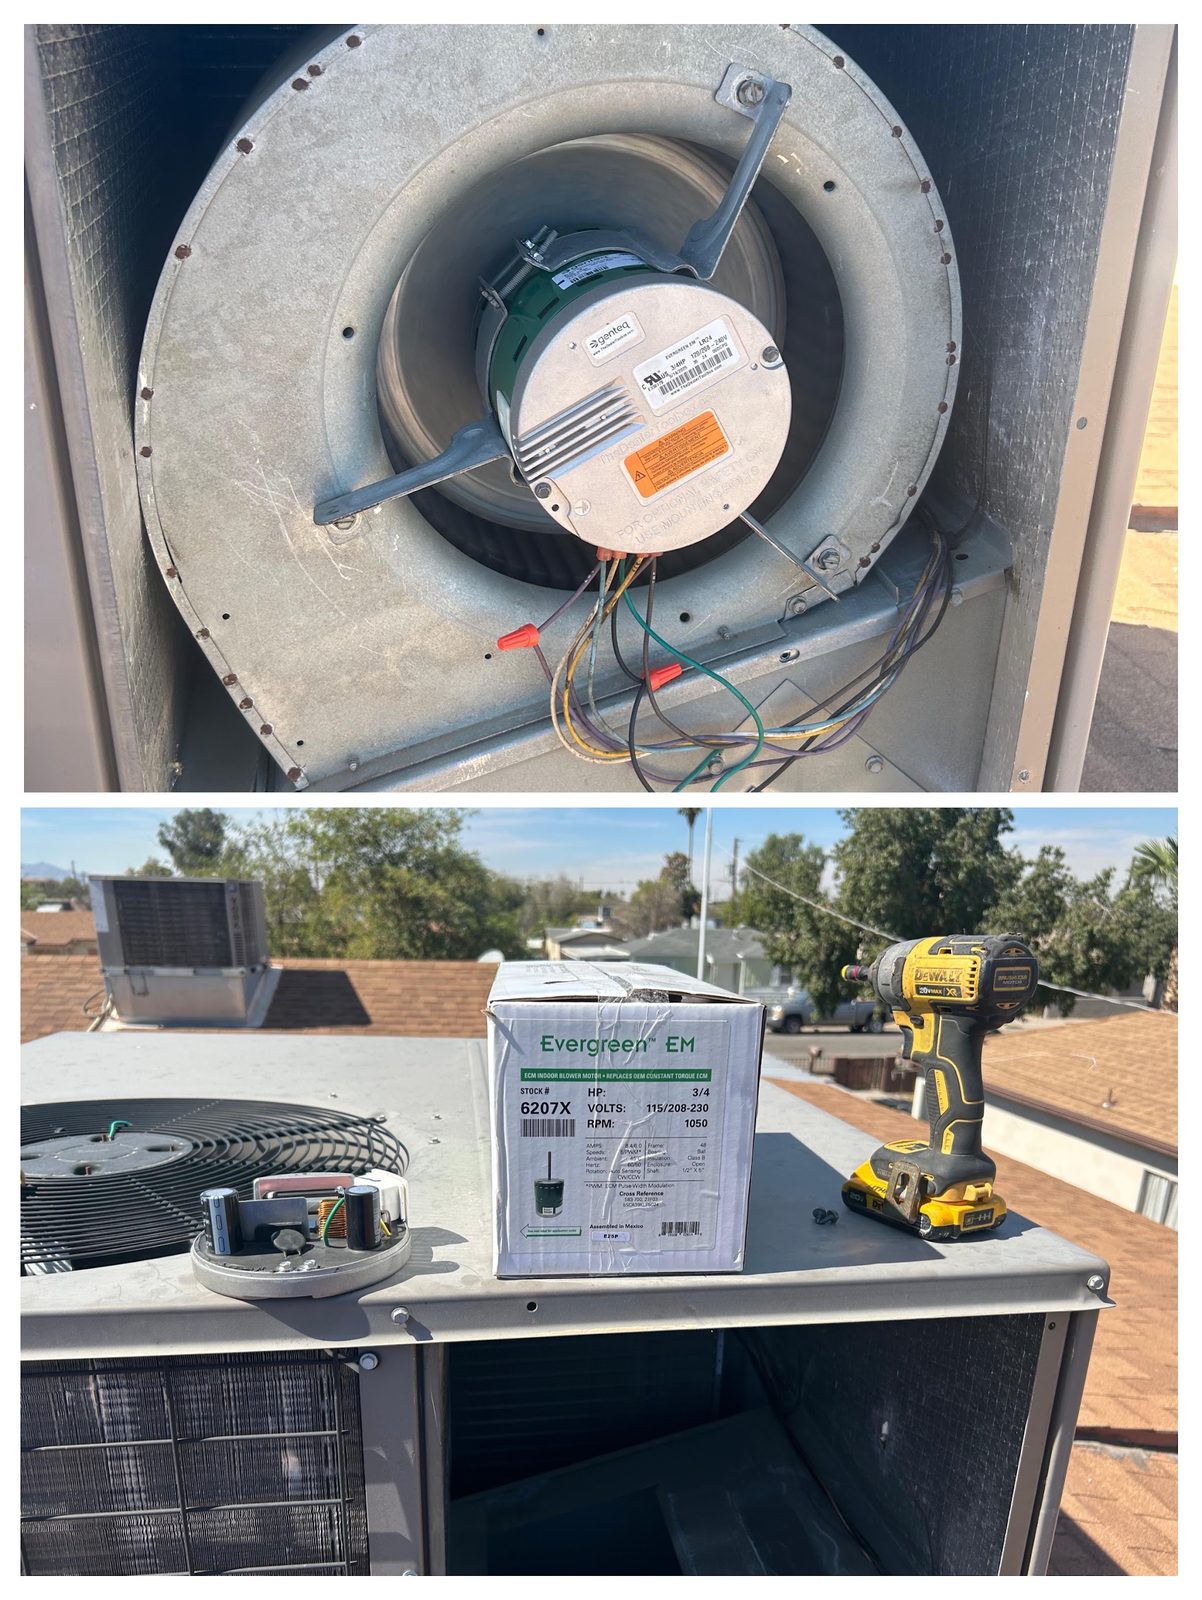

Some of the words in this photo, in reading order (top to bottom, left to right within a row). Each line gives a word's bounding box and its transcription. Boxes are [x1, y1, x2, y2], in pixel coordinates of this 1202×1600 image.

[598, 321, 631, 345] genteq
[699, 336, 712, 346] LR24
[665, 345, 688, 360] EVERGREEN
[946, 988, 957, 996] XR
[666, 1036, 694, 1052] EM
[588, 1088, 606, 1097] HP:
[692, 1088, 710, 1097] 3/4
[521, 1102, 571, 1114] 6207X
[588, 1104, 626, 1113] VOLTS:
[647, 1104, 709, 1112] 115/208-230
[588, 1120, 614, 1128] RPM:
[685, 1119, 708, 1127] 1050
